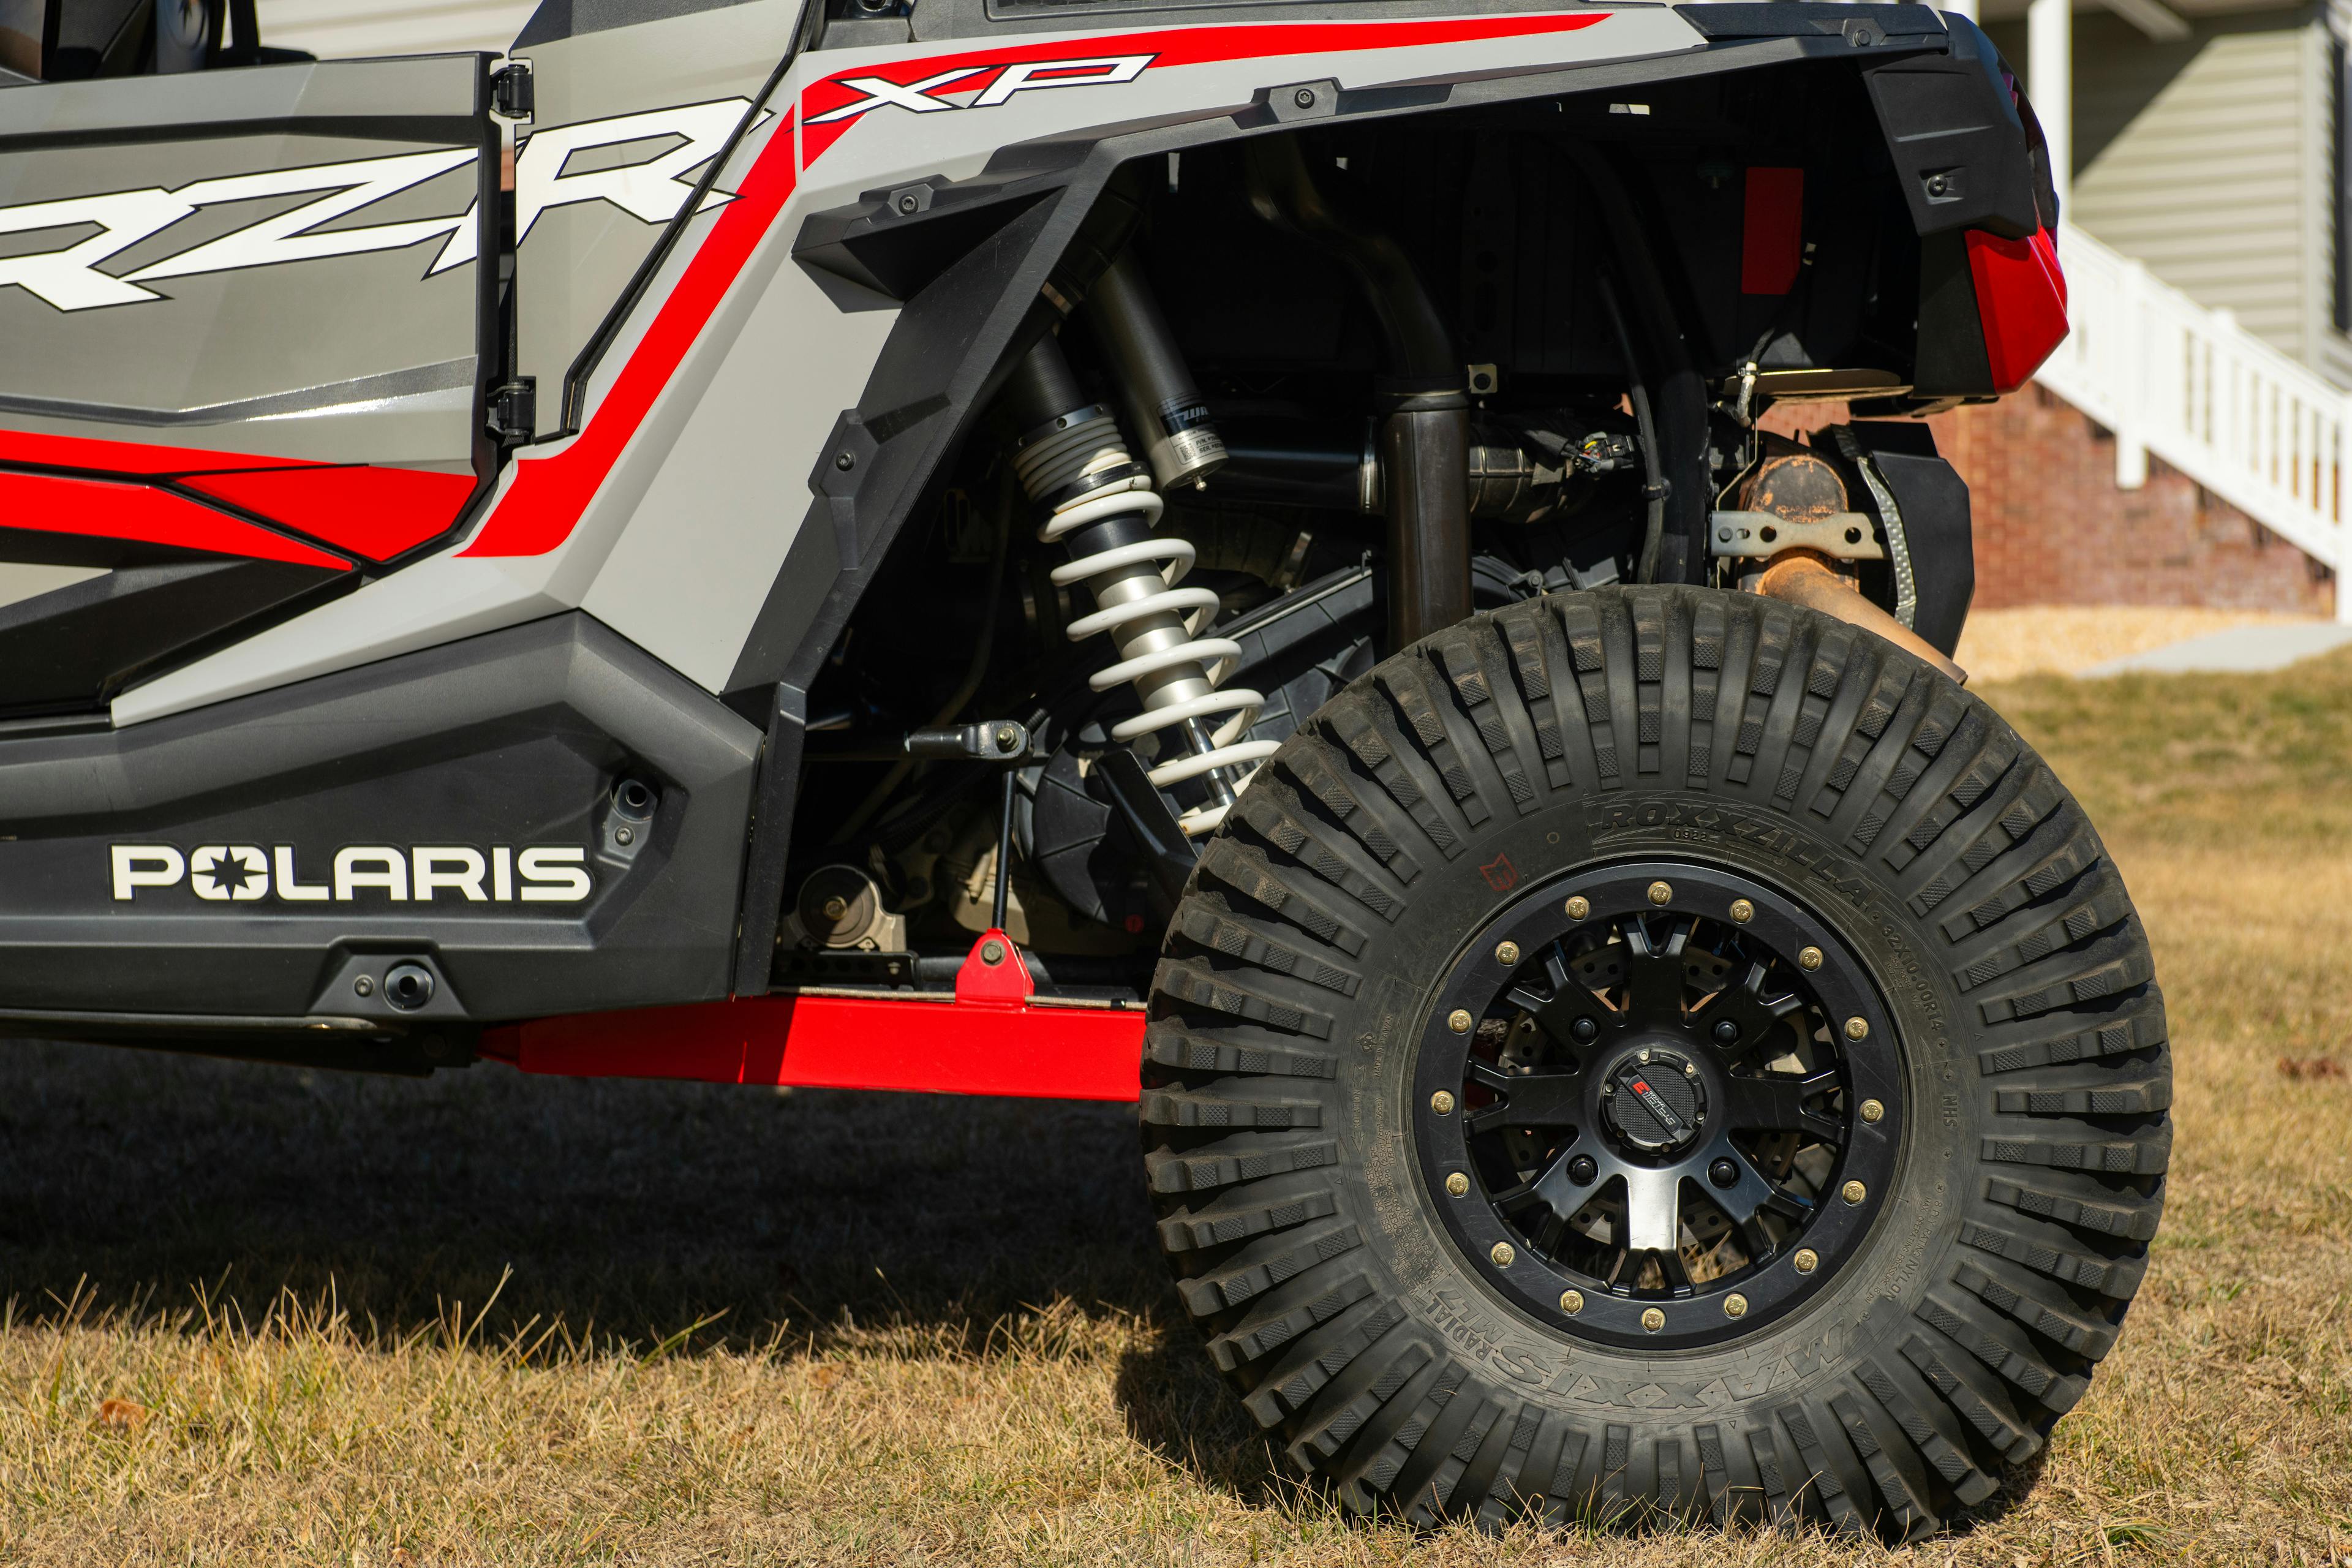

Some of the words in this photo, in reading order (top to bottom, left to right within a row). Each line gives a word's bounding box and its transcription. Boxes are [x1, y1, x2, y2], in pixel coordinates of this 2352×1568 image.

[803, 53, 1162, 124] XP
[1674, 829, 1708, 842] 0922
[1601, 802, 1874, 908] ROXXZILLA
[111, 845, 592, 901] POLARIS
[1882, 924, 1945, 1031] 32X10.00R14
[1378, 1014, 1394, 1044] TAIWAN
[1376, 1046, 1385, 1054] IN
[1372, 1056, 1383, 1077] MADE
[1352, 1090, 1361, 1129] ROTATION
[1942, 1095, 1958, 1127] NHS
[1384, 1130, 1396, 1166] TUBELESS
[1363, 1160, 1380, 1198] OWNER'S
[1382, 1168, 1396, 1196] 250kPa
[1373, 1200, 1384, 1213] OR
[1379, 1189, 1403, 1234] OPERATING
[1391, 1196, 1408, 1225] BEYOND
[1403, 1207, 1417, 1227] BEAD
[1919, 1196, 1932, 1214] MAX.
[1926, 1208, 1940, 1226] PLY
[1934, 1199, 1943, 1208] 8
[1379, 1214, 1396, 1241] LABEL
[1403, 1226, 1422, 1254] INFLATE
[1412, 1226, 1433, 1256] SEATING
[1901, 1214, 1926, 1253] OPERATING
[1910, 1226, 1933, 1258] RATING
[1391, 1240, 1415, 1274] VEHICLE
[1398, 1234, 1414, 1253] FOR
[1409, 1253, 1434, 1285] MANUAL
[1419, 1253, 1432, 1268] NOT
[1429, 1255, 1446, 1275] WHEN
[1429, 1268, 1440, 1280] DO
[1879, 1252, 1906, 1286] PRESSURE
[1389, 1256, 1419, 1296] WARNING
[1411, 1273, 1427, 1290] SEE
[1872, 1284, 1883, 1294] 18
[1882, 1257, 1919, 1303] NYLON
[1863, 1292, 1876, 1305] psi
[1424, 1296, 1490, 1361] RADIAL
[1435, 1289, 1505, 1348] ML7
[1494, 1320, 1846, 1409] MAXXIS
